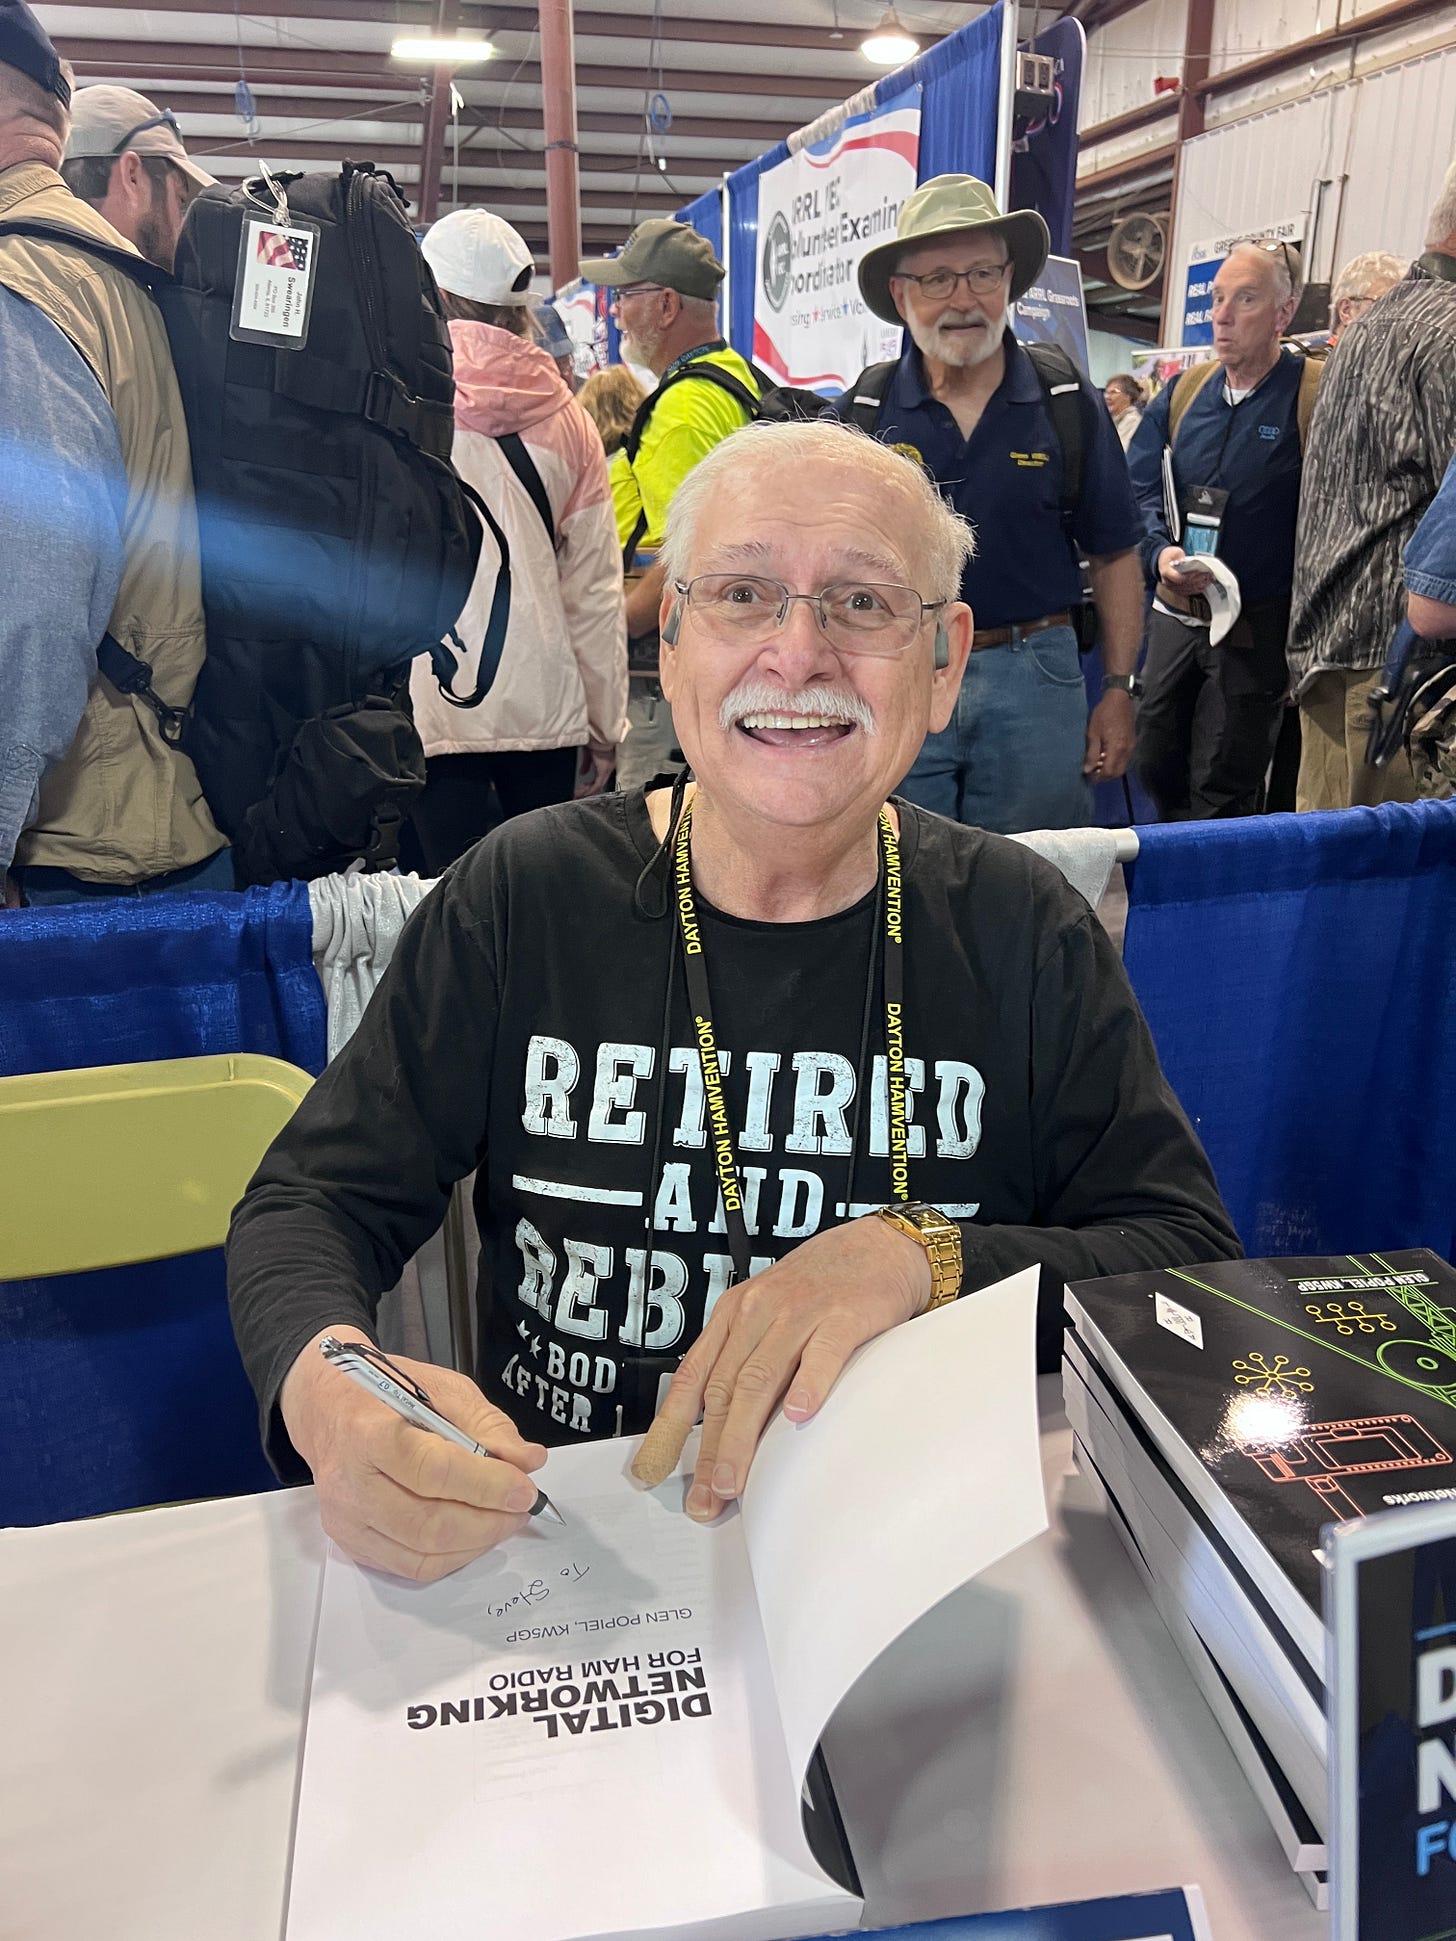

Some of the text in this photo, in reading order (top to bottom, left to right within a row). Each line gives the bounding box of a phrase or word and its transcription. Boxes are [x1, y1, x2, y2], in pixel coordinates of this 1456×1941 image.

[283, 276, 296, 328] Swearingen
[678, 887, 702, 955] DAYTON
[887, 1003, 903, 1073] DAYTON
[521, 1035, 986, 1160] RETIRED
[646, 1162, 825, 1239] AND
[715, 1139, 741, 1211] DAYTON
[1297, 1272, 1430, 1292] GLEN POPIEL, KW5GP
[501, 1354, 593, 1433] AFTER
[488, 1563, 590, 1617] To Steve,
[506, 1608, 693, 1643] GLEN POPIEL, KW5GP
[407, 1666, 706, 1730] NETWORKING
[489, 1648, 702, 1691] FOR HAM RADIO
[533, 1692, 712, 1739] DIGITAL
